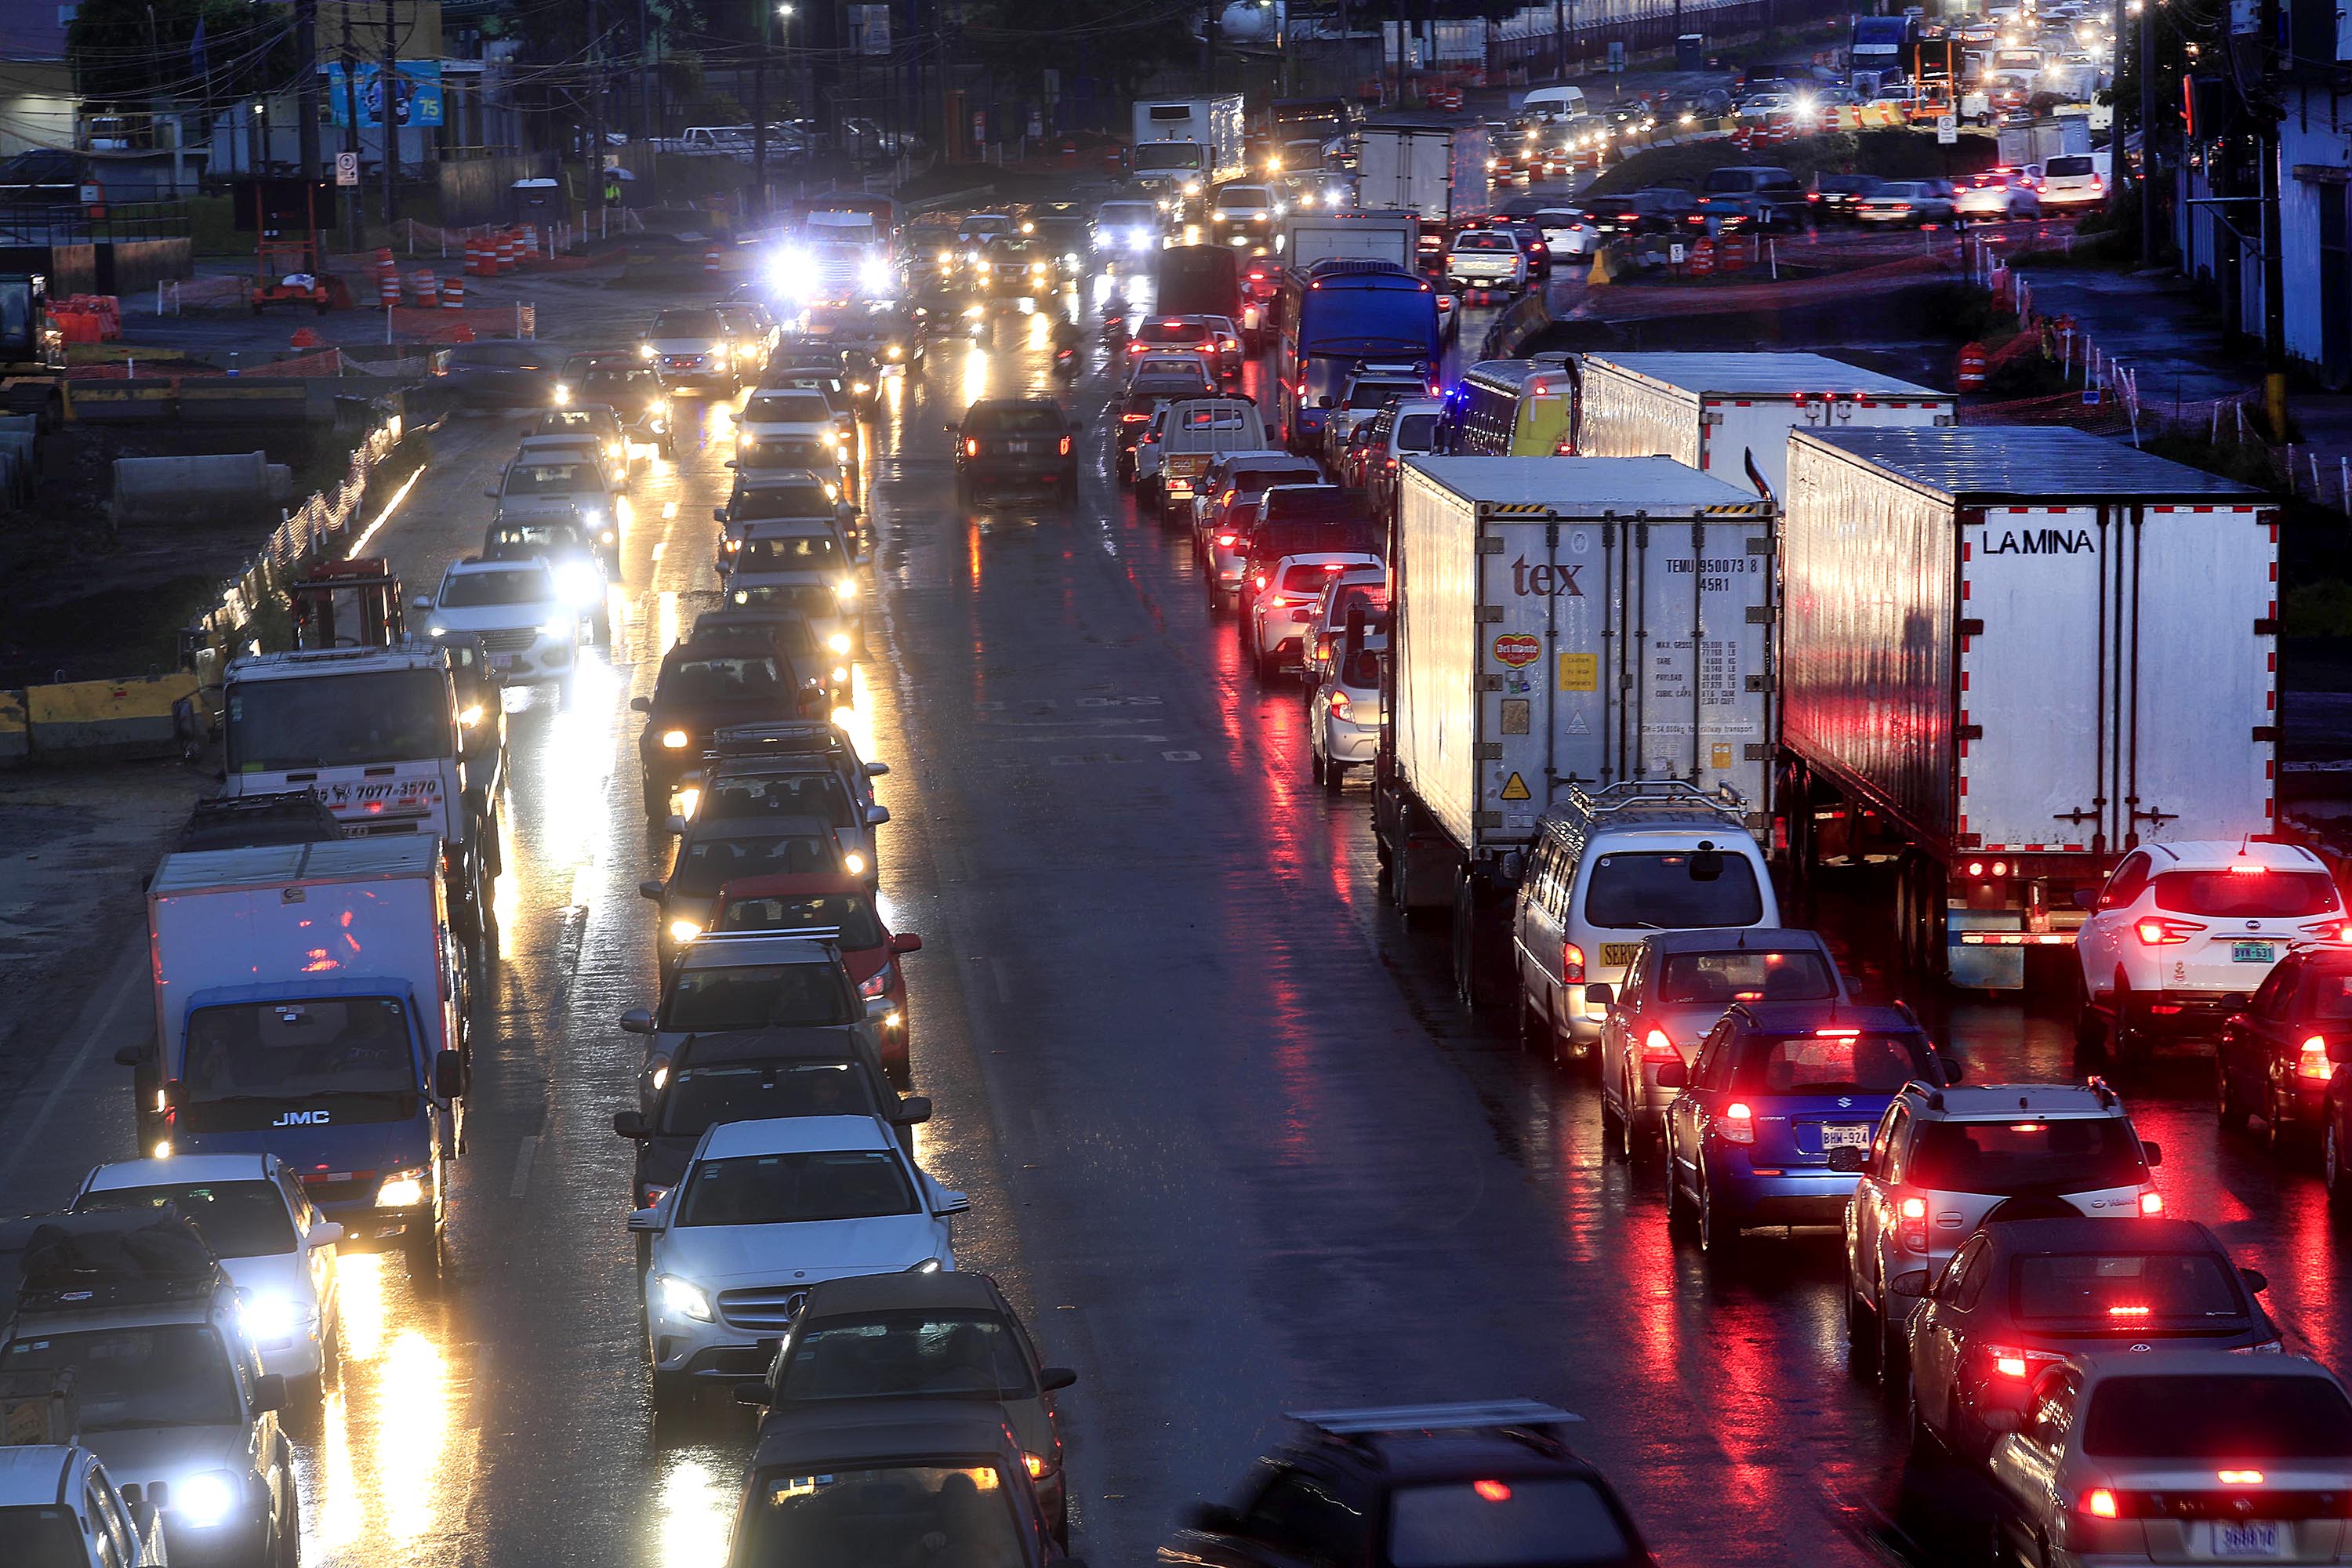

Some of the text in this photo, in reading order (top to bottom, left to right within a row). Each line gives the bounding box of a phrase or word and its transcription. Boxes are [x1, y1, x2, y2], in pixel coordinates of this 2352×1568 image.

[419, 99, 440, 117] 75
[1983, 529, 2095, 554] LAMINA
[1512, 552, 1584, 597] tex
[1666, 559, 1758, 573] TEMU 950073 8
[1700, 578, 1729, 591] 45R1
[356, 779, 436, 800] 7077-3570
[272, 1110, 331, 1126] JMC
